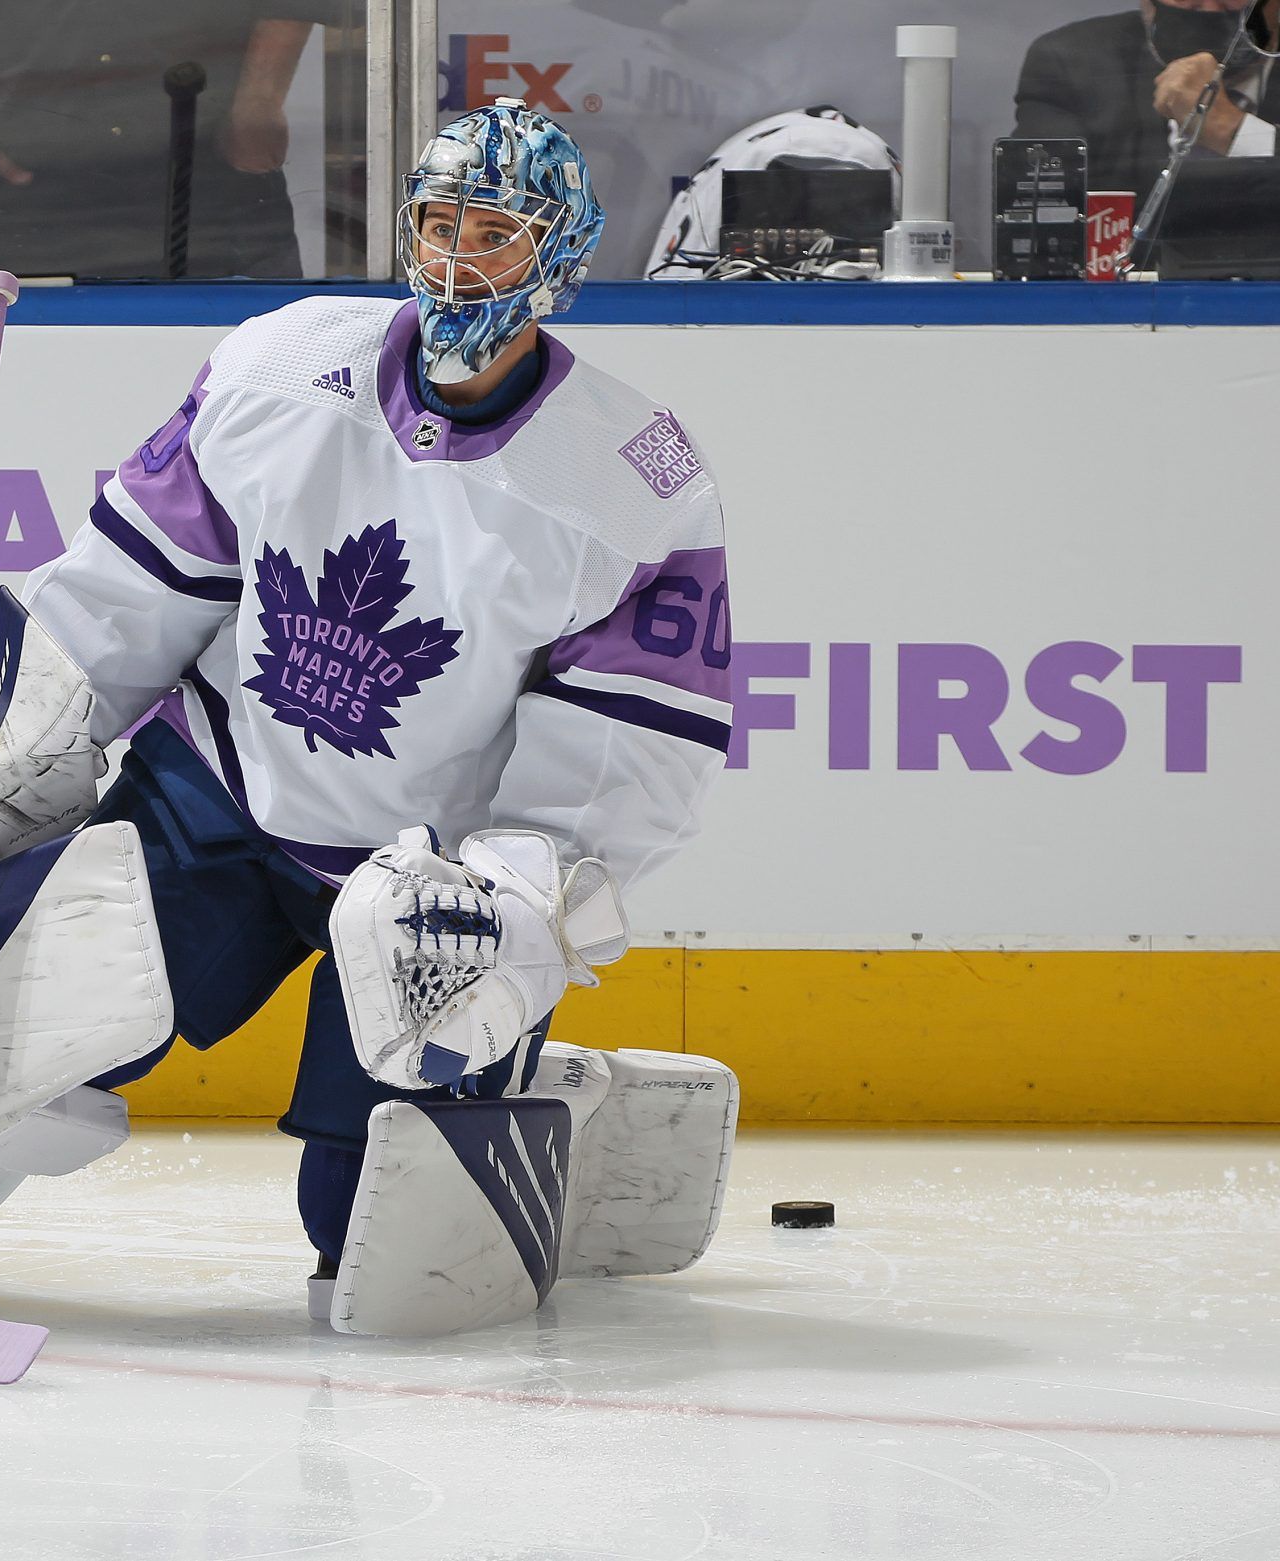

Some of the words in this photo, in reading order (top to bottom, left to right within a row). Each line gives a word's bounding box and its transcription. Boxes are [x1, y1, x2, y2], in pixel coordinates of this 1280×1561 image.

[1087, 207, 1130, 243] Tim
[312, 378, 356, 400] adidas
[627, 419, 678, 462] HOCKEY
[640, 435, 689, 478] FIGHTS
[631, 576, 731, 670] 60
[277, 613, 404, 687] TORONTO
[287, 641, 376, 699] MAPLE
[280, 666, 366, 723] LEAFS
[724, 641, 1242, 775] FIRST
[640, 1080, 716, 1091] HYPERLITE
